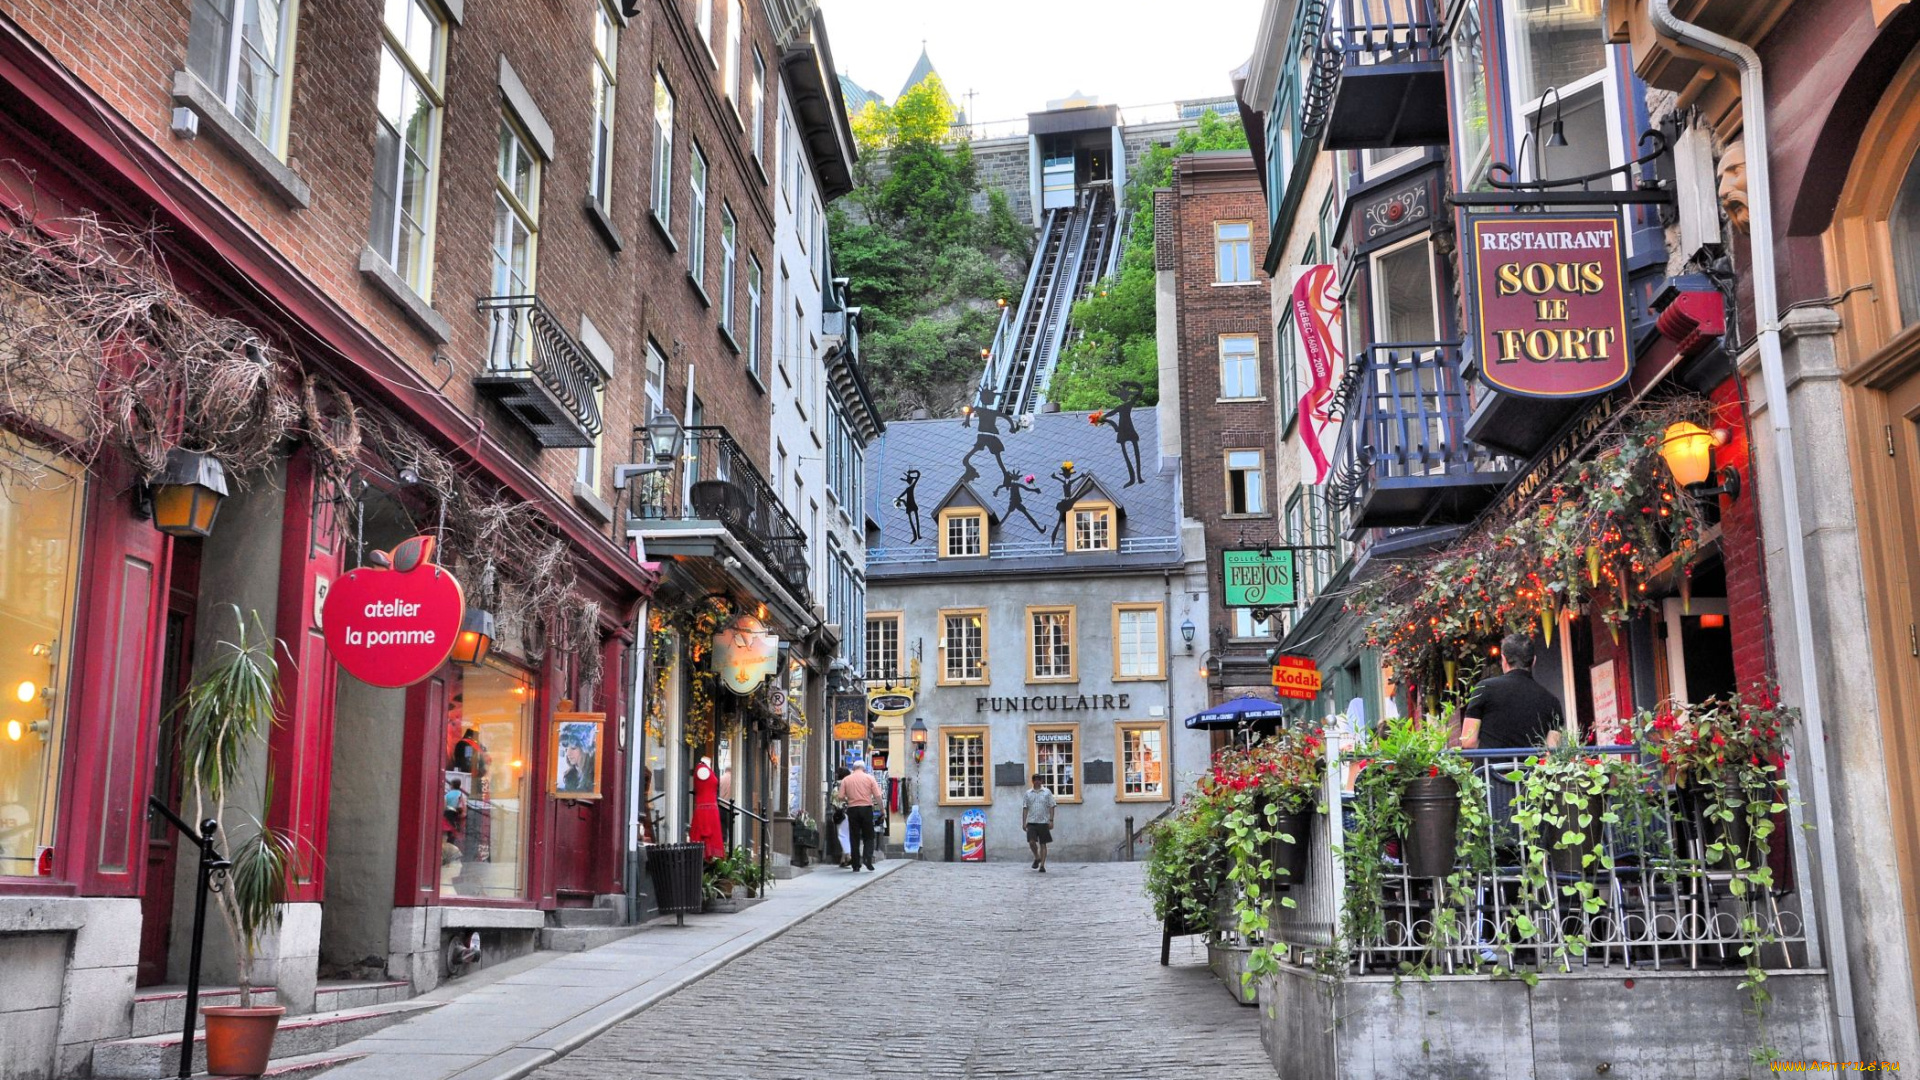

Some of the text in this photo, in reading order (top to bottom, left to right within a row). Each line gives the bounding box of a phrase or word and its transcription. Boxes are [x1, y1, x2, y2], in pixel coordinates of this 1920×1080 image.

[1481, 229, 1613, 251] RESTAURANT
[1496, 261, 1604, 296] SOUS
[1536, 299, 1569, 321] LE
[1296, 300, 1314, 335] QUÉBEC
[1307, 335, 1318, 354] 1608
[1313, 357, 1326, 378] 2008
[1495, 327, 1615, 362] FORT
[364, 598, 421, 618] atelier
[345, 626, 436, 649] la pomme
[1275, 669, 1320, 687] Kodak
[976, 693, 1131, 713] FUNICULAIRE
[1036, 734, 1072, 742] SOUVENIRS
